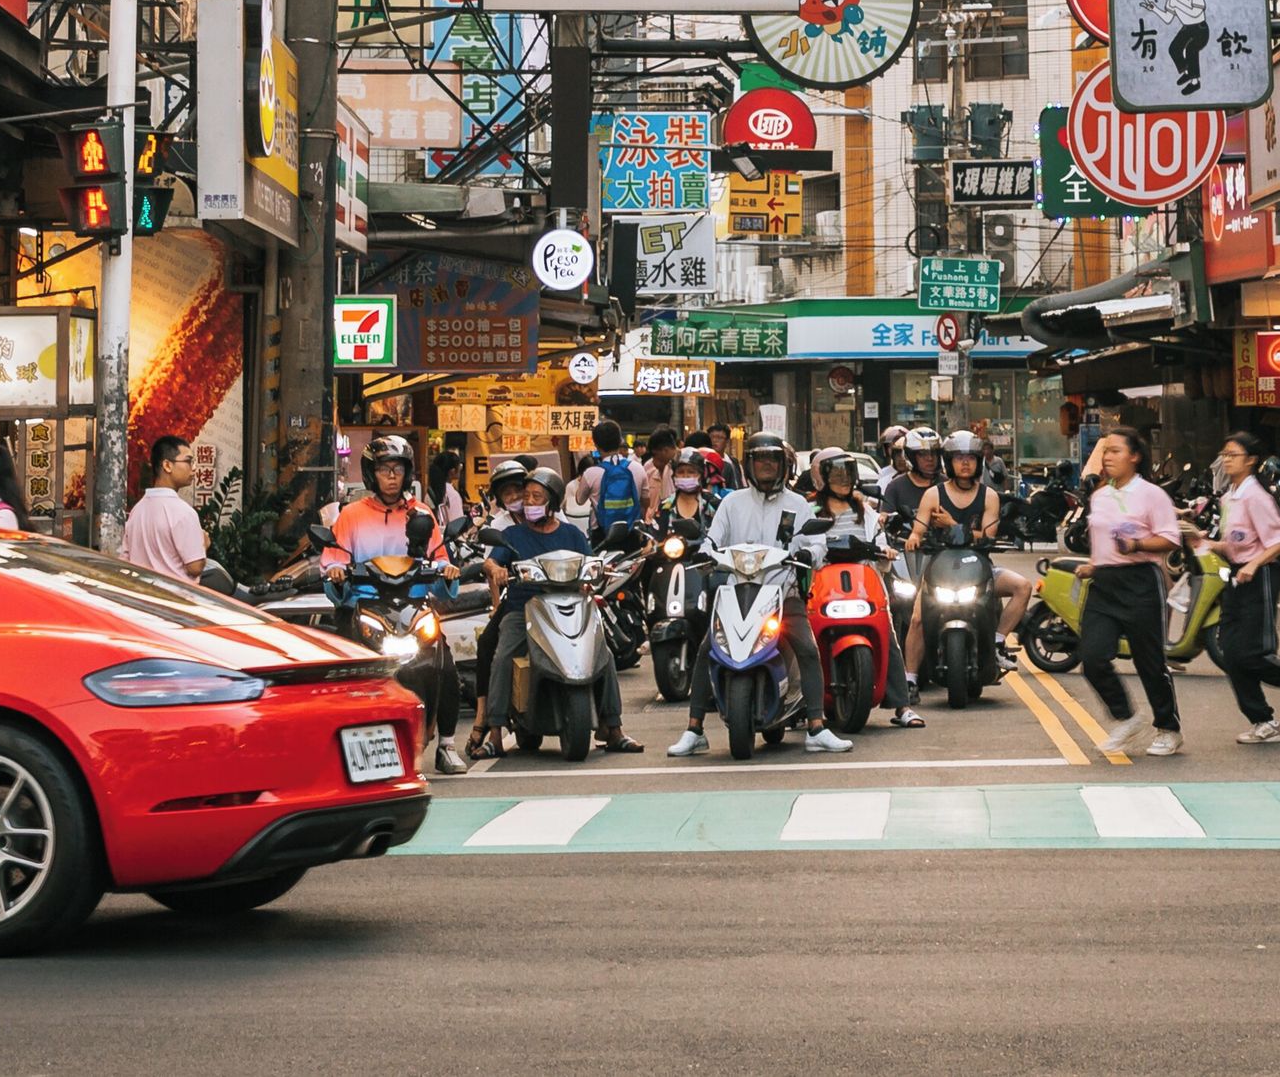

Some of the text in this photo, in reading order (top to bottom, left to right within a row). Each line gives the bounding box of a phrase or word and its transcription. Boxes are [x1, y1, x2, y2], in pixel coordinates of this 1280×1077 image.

[777, 28, 811, 60] 小
[1131, 18, 1253, 60] 有 飲
[615, 117, 706, 169] 泳裝
[615, 172, 706, 209] 大拍賣
[963, 166, 1033, 196] 現場維修
[640, 222, 687, 255] ET
[543, 242, 579, 272] Preso
[553, 263, 576, 278] tea
[974, 272, 986, 283] Ln
[676, 327, 784, 355] 阿宗青草茶
[871, 322, 1010, 347] 全家 FaMart
[635, 366, 711, 395] 烤地瓜
[1258, 392, 1276, 404] 150
